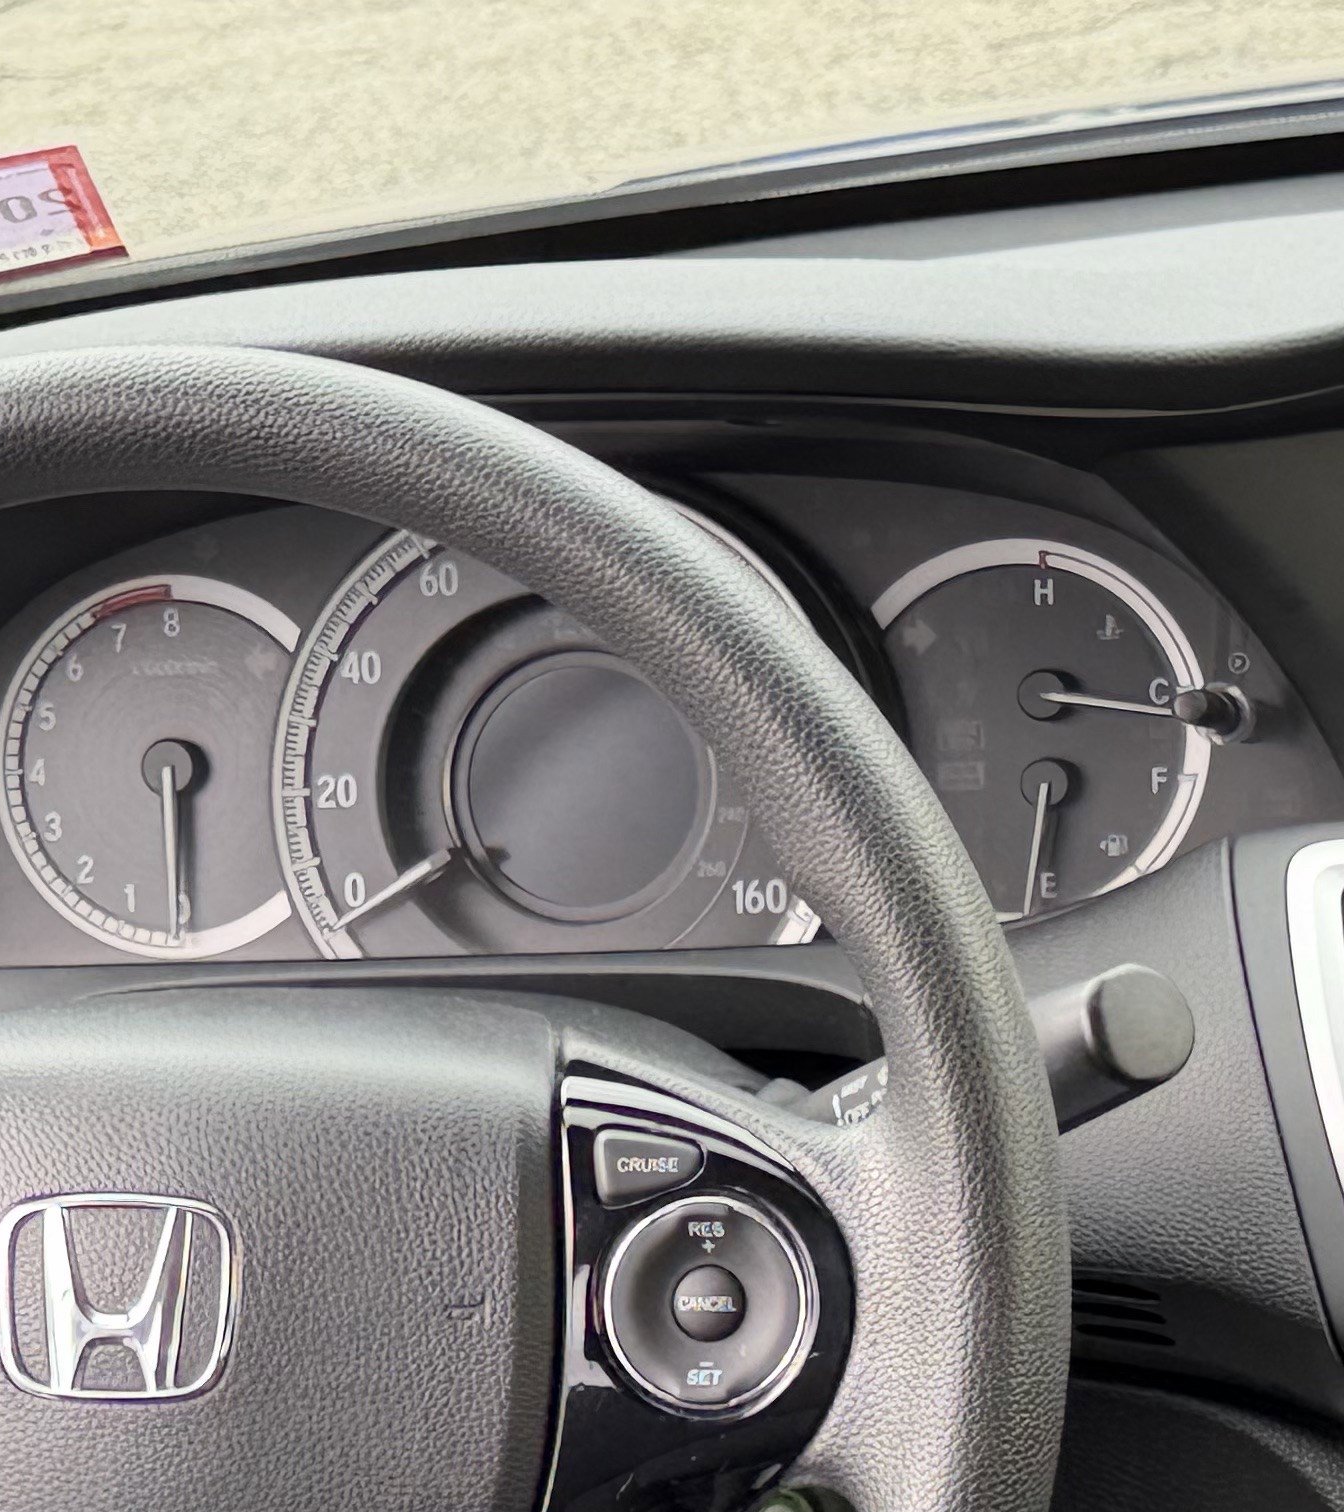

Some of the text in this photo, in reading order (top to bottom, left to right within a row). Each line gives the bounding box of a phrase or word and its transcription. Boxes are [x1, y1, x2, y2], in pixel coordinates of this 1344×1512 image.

[419, 562, 459, 597] 60
[1033, 579, 1054, 605] H
[163, 607, 182, 637] 8
[111, 624, 127, 653] 7
[65, 655, 84, 682] 6
[340, 650, 382, 684] 40
[1148, 678, 1169, 705] C
[38, 702, 57, 731] 5
[29, 760, 46, 786] 4
[1150, 766, 1168, 794] F
[316, 775, 358, 809] 20
[43, 812, 62, 842] 3
[76, 854, 96, 884] 2
[123, 883, 137, 913] 1
[344, 872, 366, 908] 0
[731, 878, 788, 915] 160
[1040, 871, 1058, 899] E
[616, 1157, 680, 1174] CRUISE
[687, 1221, 726, 1238] RES
[686, 1369, 724, 1386] SET
